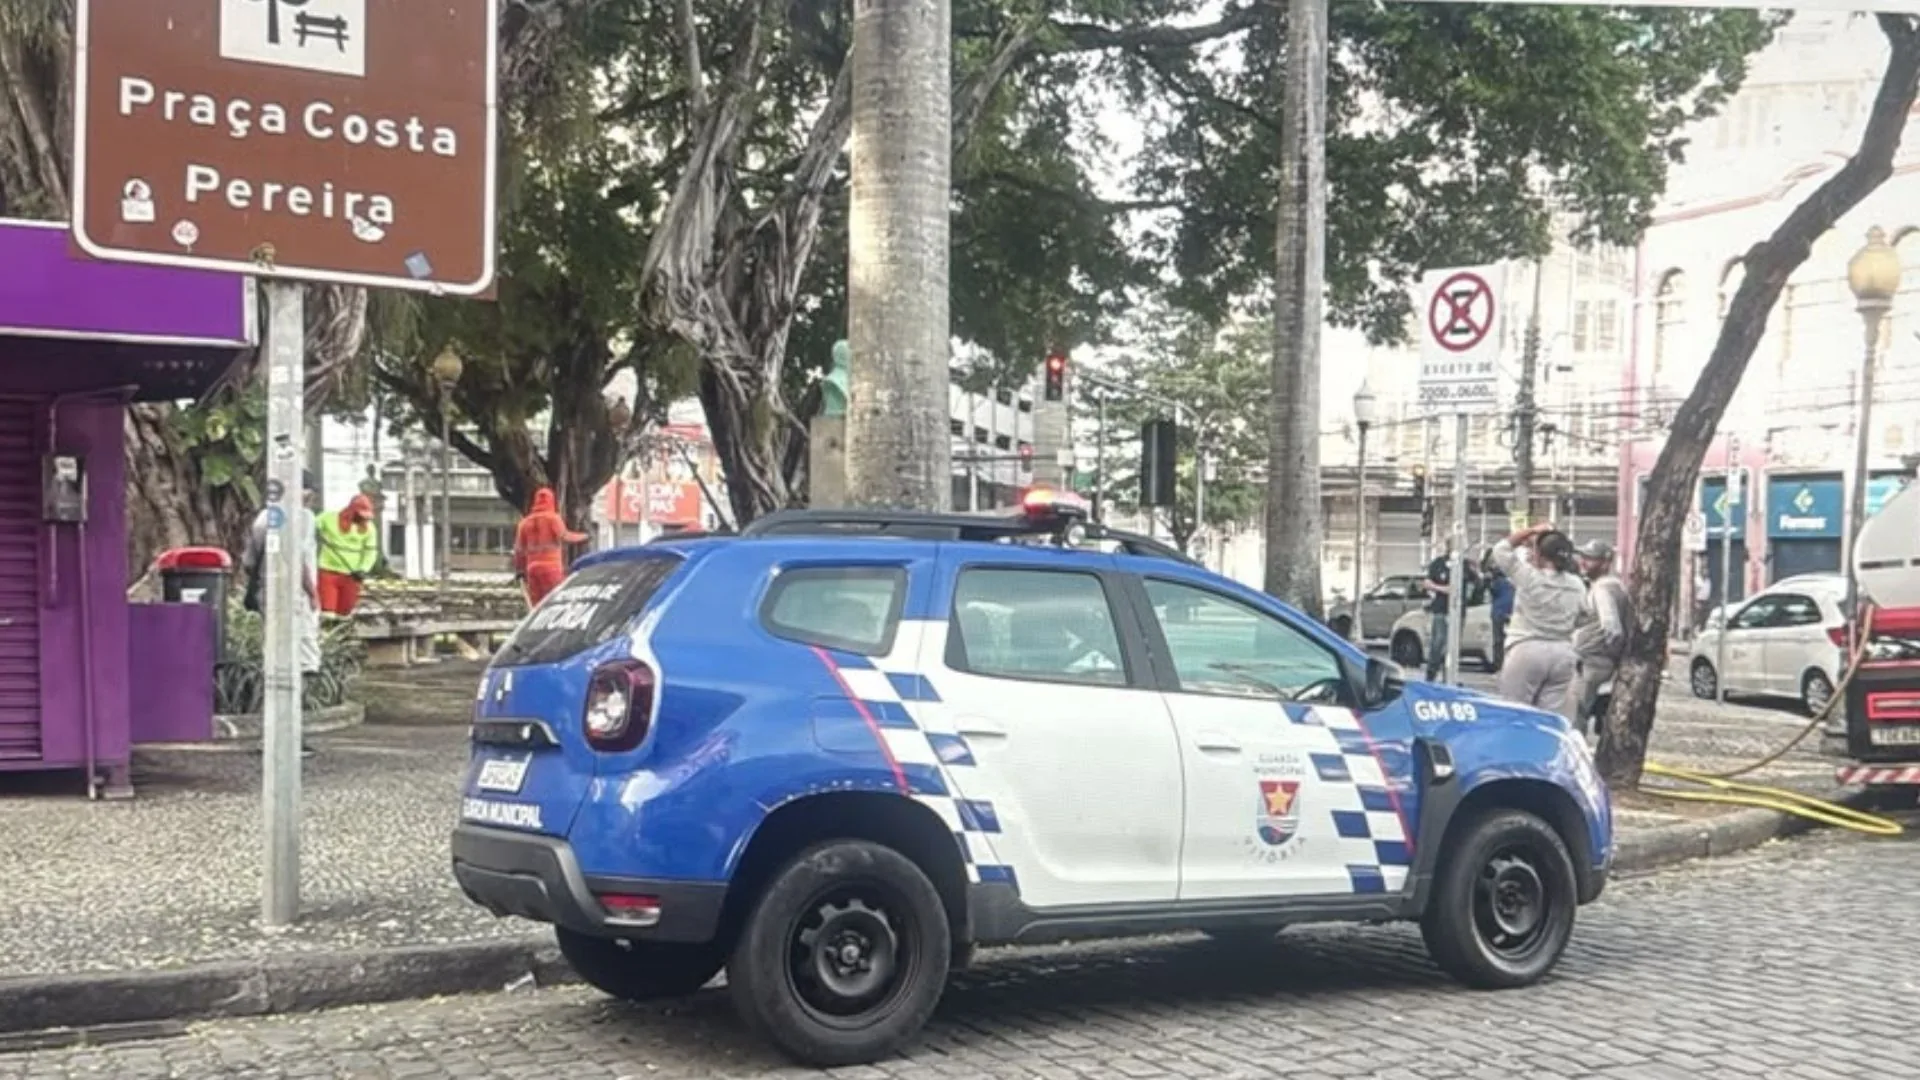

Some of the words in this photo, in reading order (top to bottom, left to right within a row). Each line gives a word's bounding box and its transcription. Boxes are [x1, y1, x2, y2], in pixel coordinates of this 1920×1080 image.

[119, 76, 287, 138] Praça
[303, 102, 457, 157] Costa
[185, 164, 394, 225] Pereira
[1414, 701, 1451, 721] GM
[1452, 702, 1478, 722] 89
